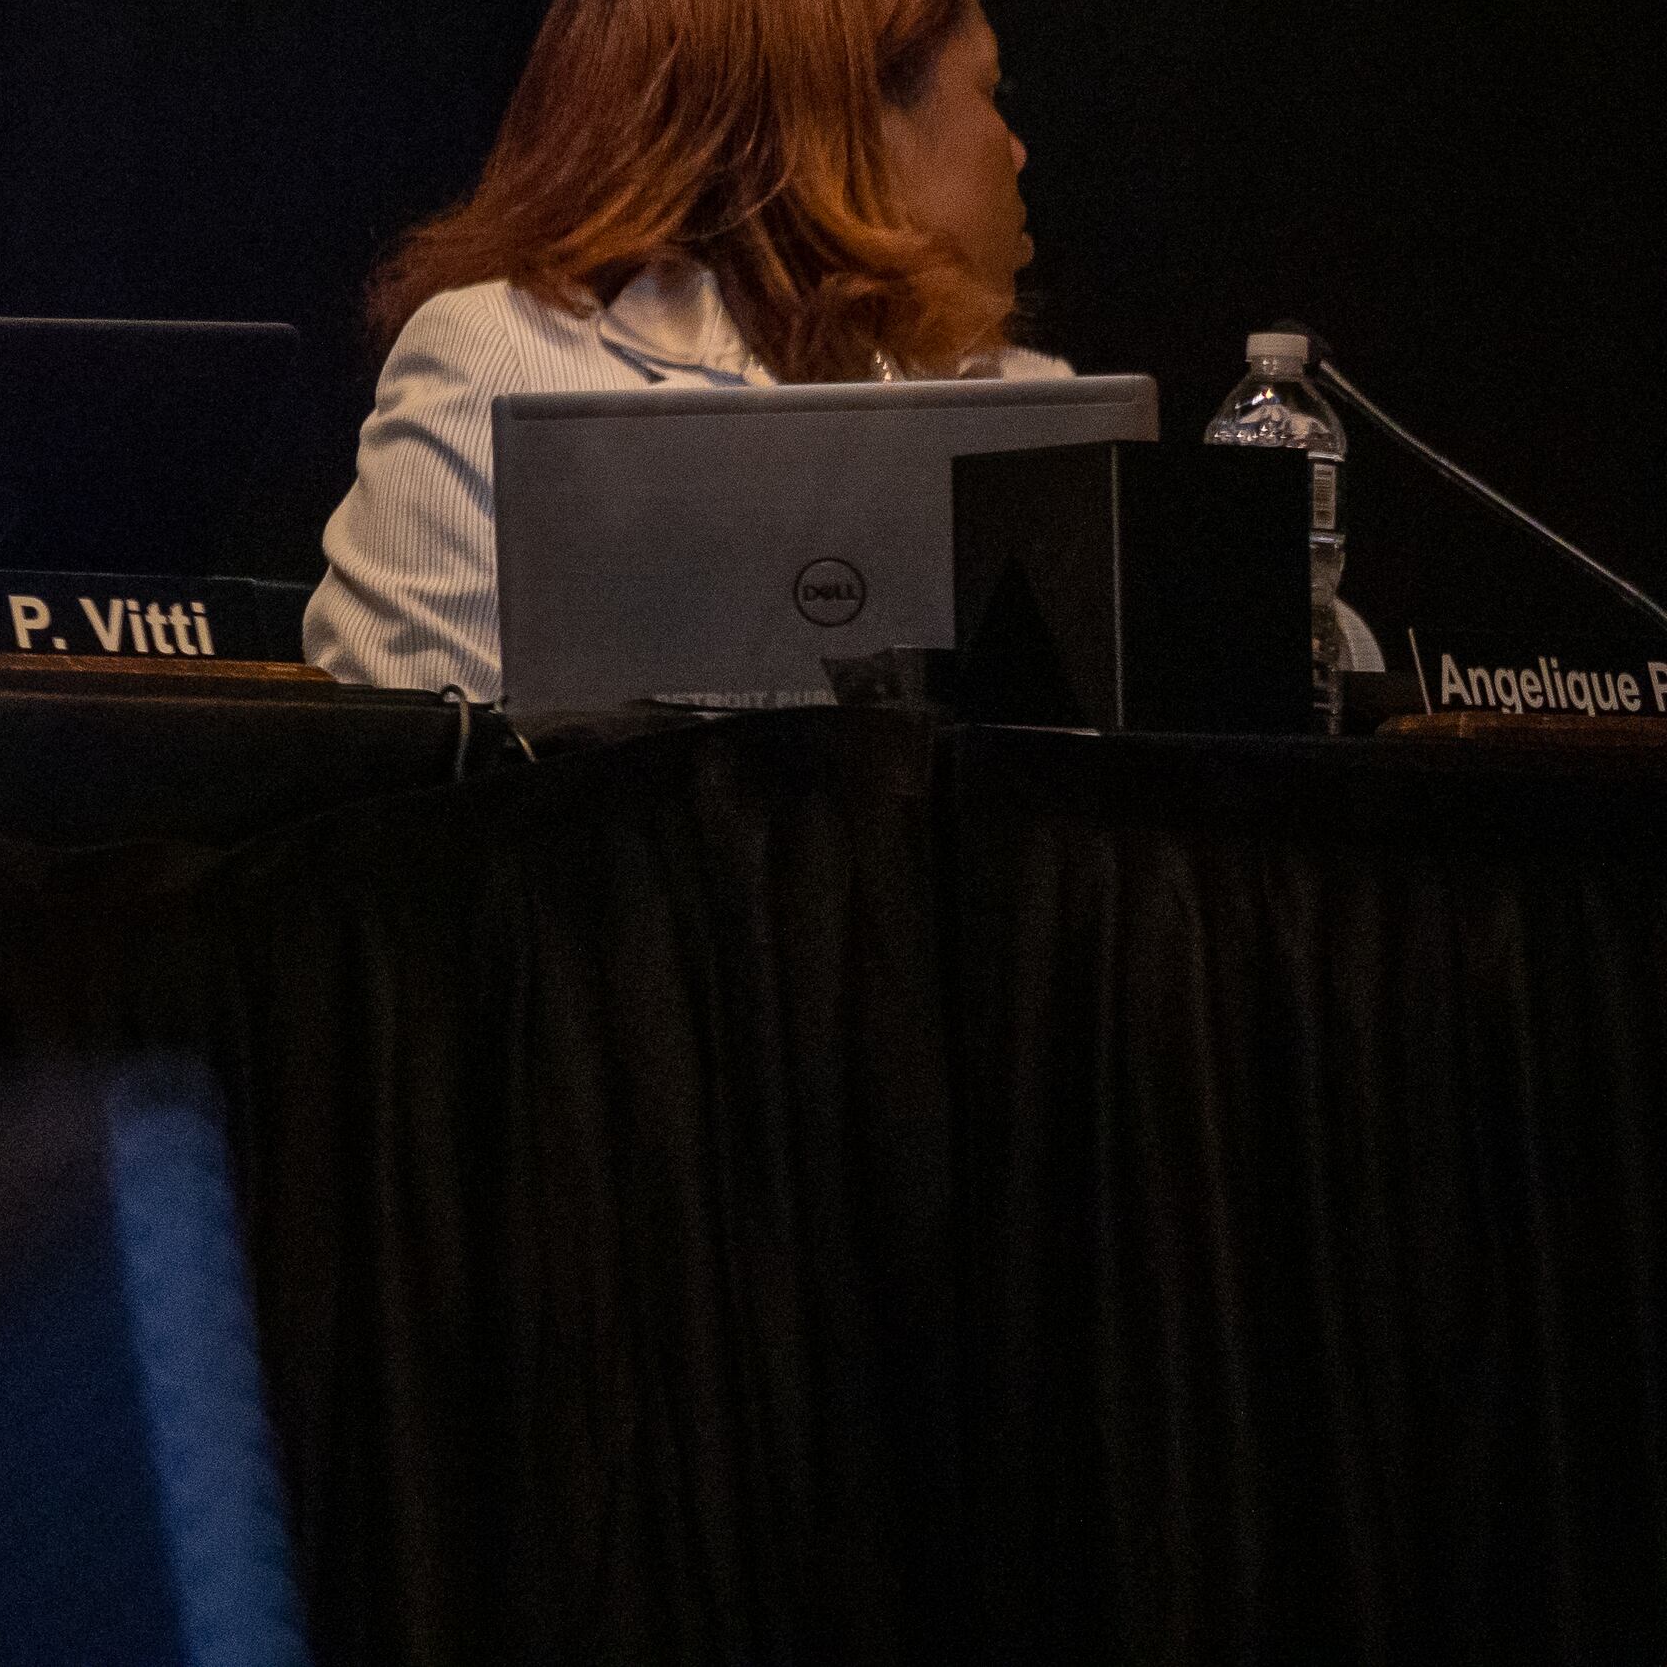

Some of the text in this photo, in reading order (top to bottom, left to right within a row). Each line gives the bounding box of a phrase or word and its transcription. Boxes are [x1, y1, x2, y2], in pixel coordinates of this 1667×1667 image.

[803, 582, 858, 602] DELL
[8, 595, 67, 649] P.
[79, 598, 215, 656] Vitti
[1441, 653, 1642, 717] Angelique
